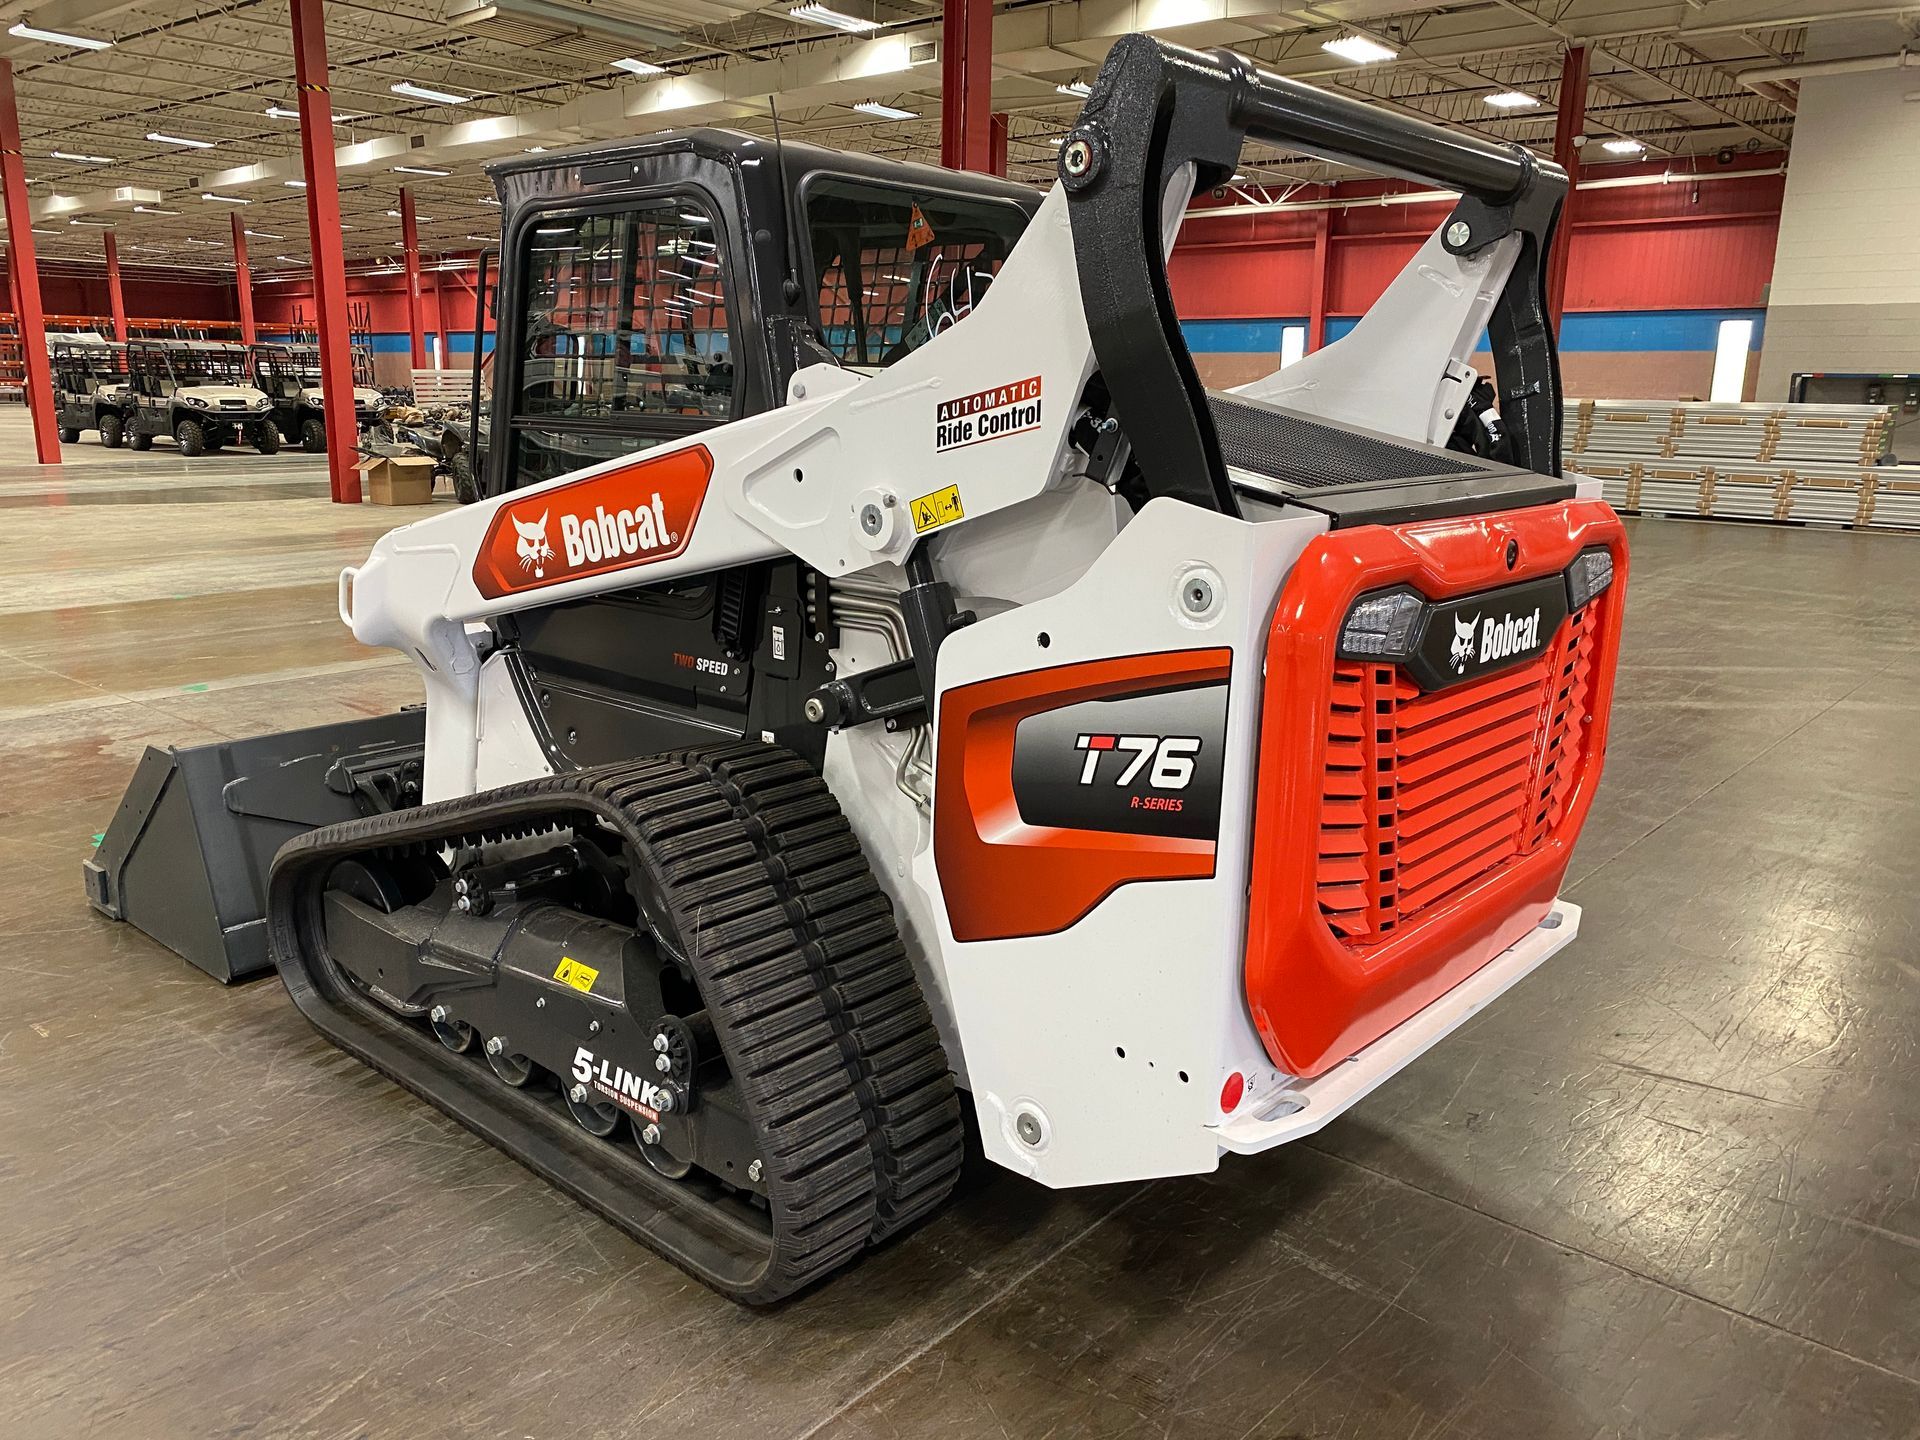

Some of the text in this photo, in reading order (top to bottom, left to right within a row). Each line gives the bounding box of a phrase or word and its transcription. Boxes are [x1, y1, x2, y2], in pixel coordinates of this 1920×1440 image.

[936, 399, 1041, 448] Ride Control
[940, 380, 1038, 421] AUTOMATIC
[1479, 607, 1540, 664] Bobcat
[672, 652, 729, 676] TWO SPEED
[1075, 733, 1202, 790] T76
[1130, 796, 1184, 812] R-SERIES
[571, 1046, 660, 1111] 5-LINK
